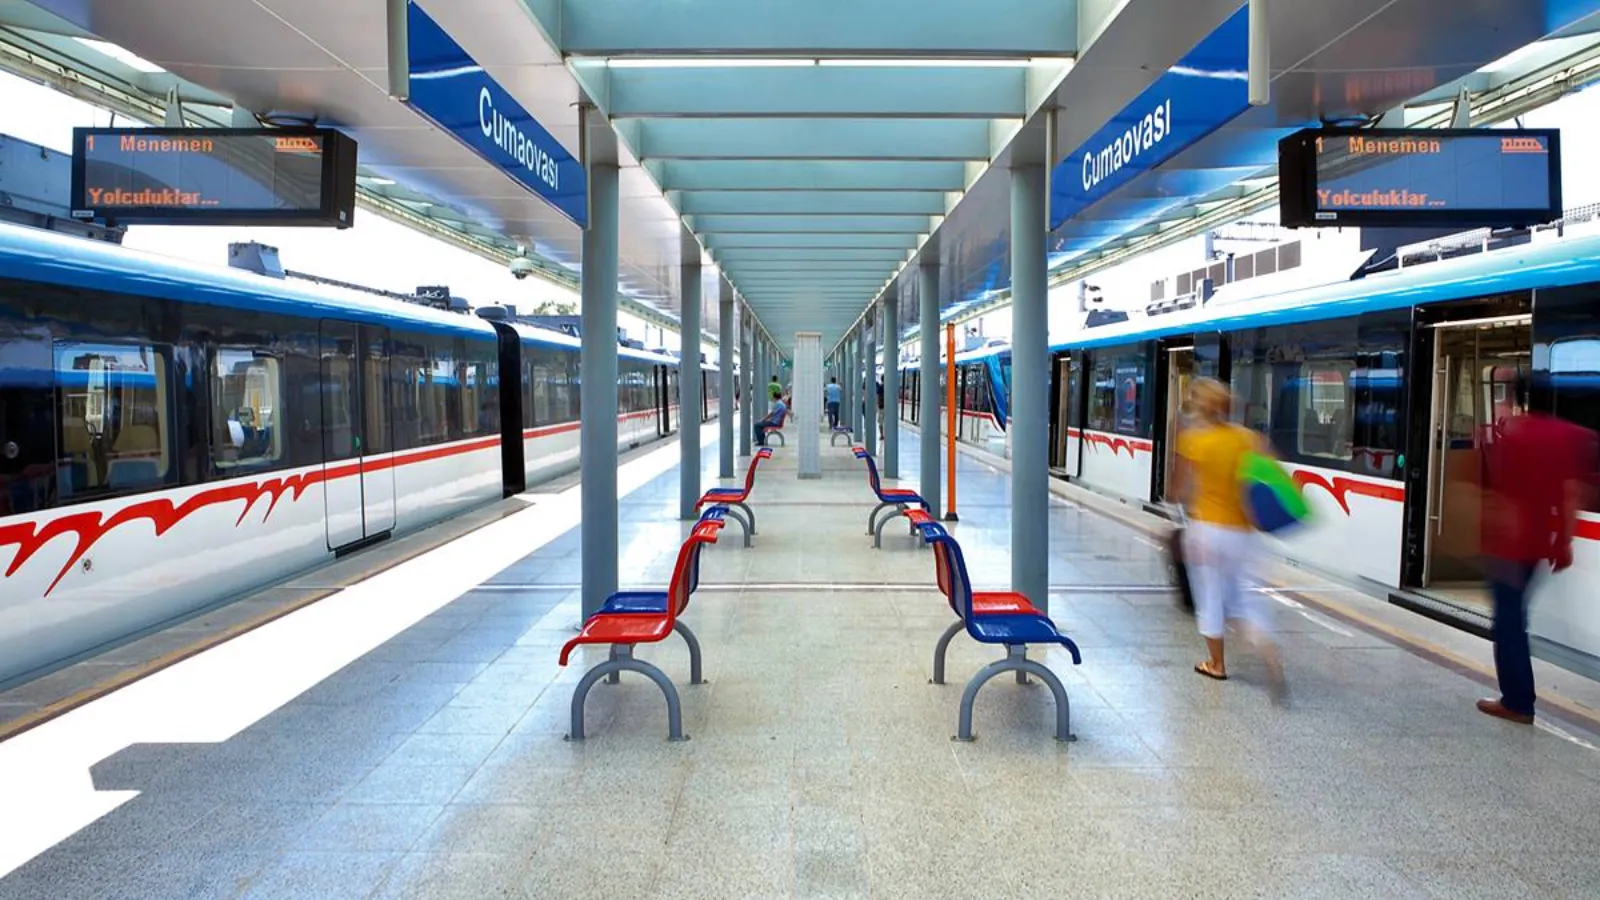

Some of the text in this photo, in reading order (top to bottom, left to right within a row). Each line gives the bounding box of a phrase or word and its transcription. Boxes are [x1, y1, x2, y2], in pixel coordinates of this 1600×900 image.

[86, 134, 213, 152] 1 Menemen
[1315, 136, 1441, 153] 1 Menemen
